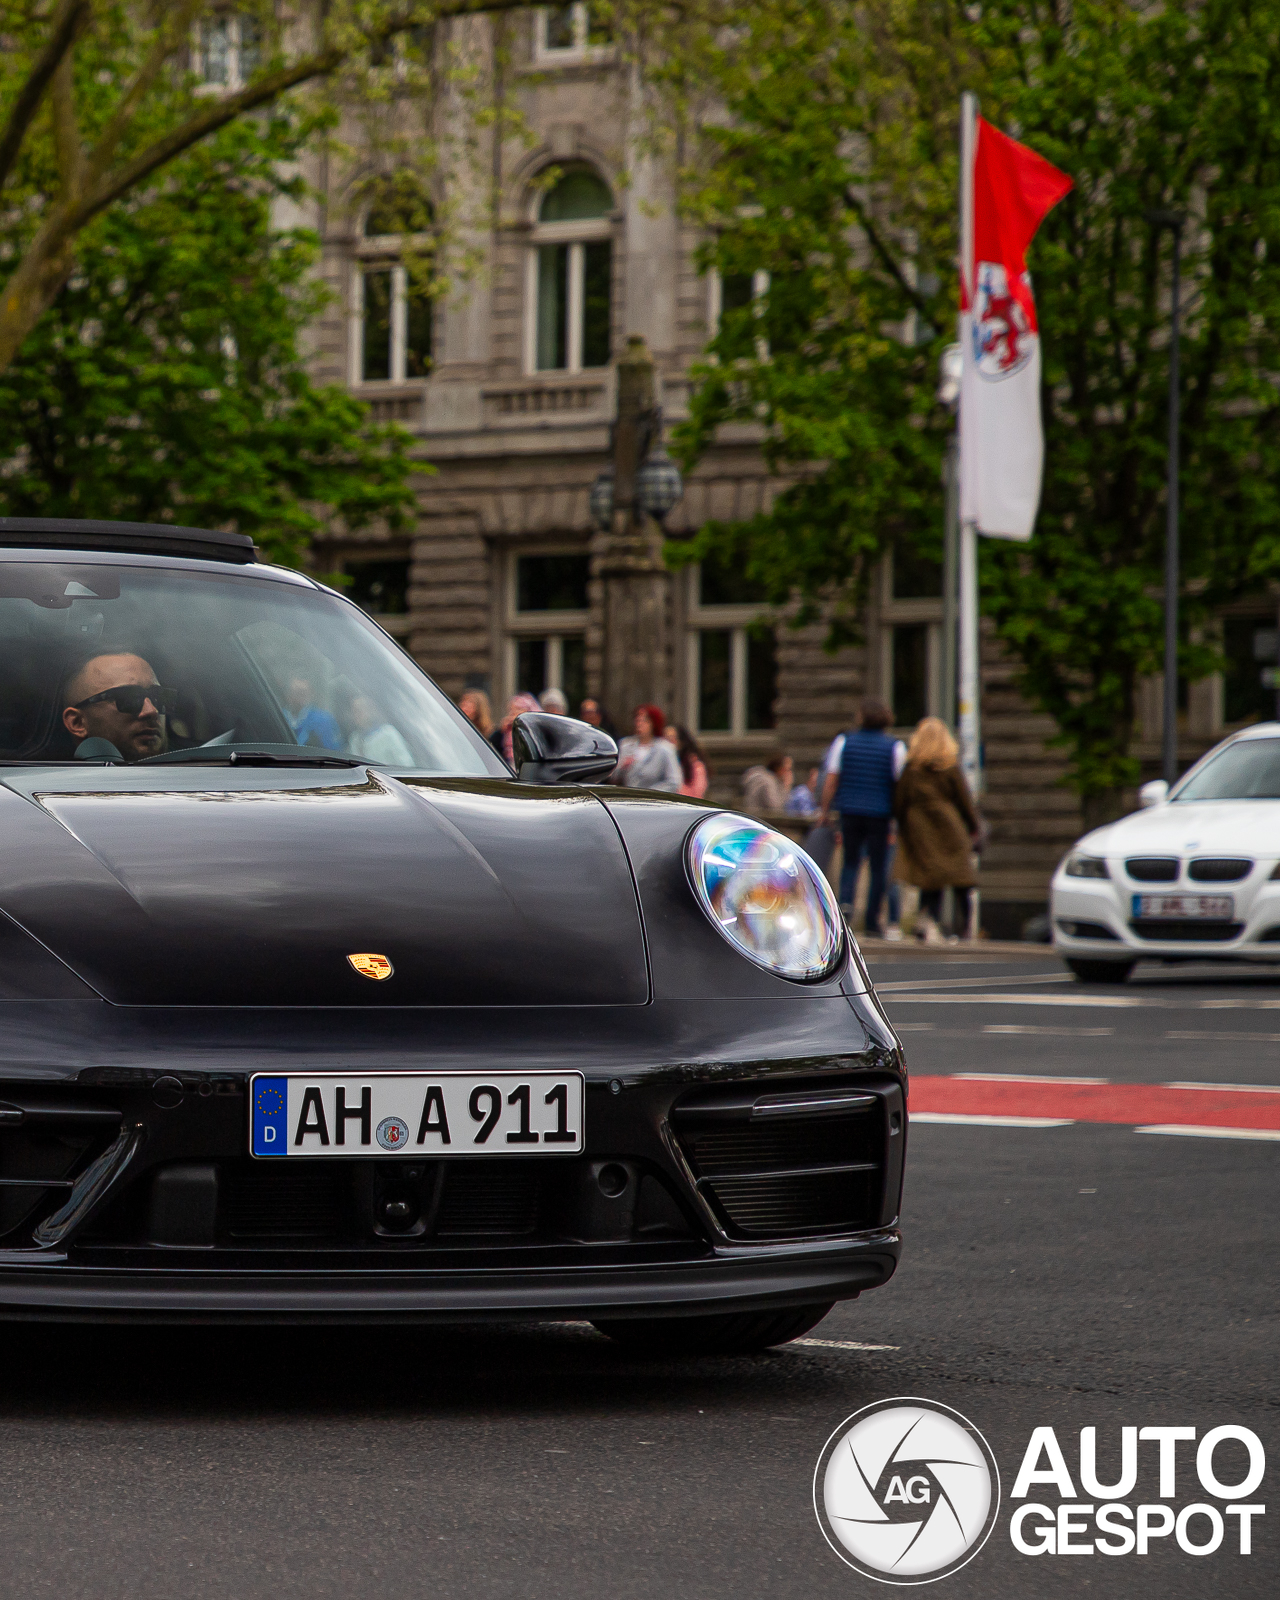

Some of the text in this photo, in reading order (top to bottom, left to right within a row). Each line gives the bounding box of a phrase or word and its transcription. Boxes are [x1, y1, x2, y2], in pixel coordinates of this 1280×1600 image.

[263, 1126, 277, 1143] D
[294, 1084, 577, 1146] AH A 911
